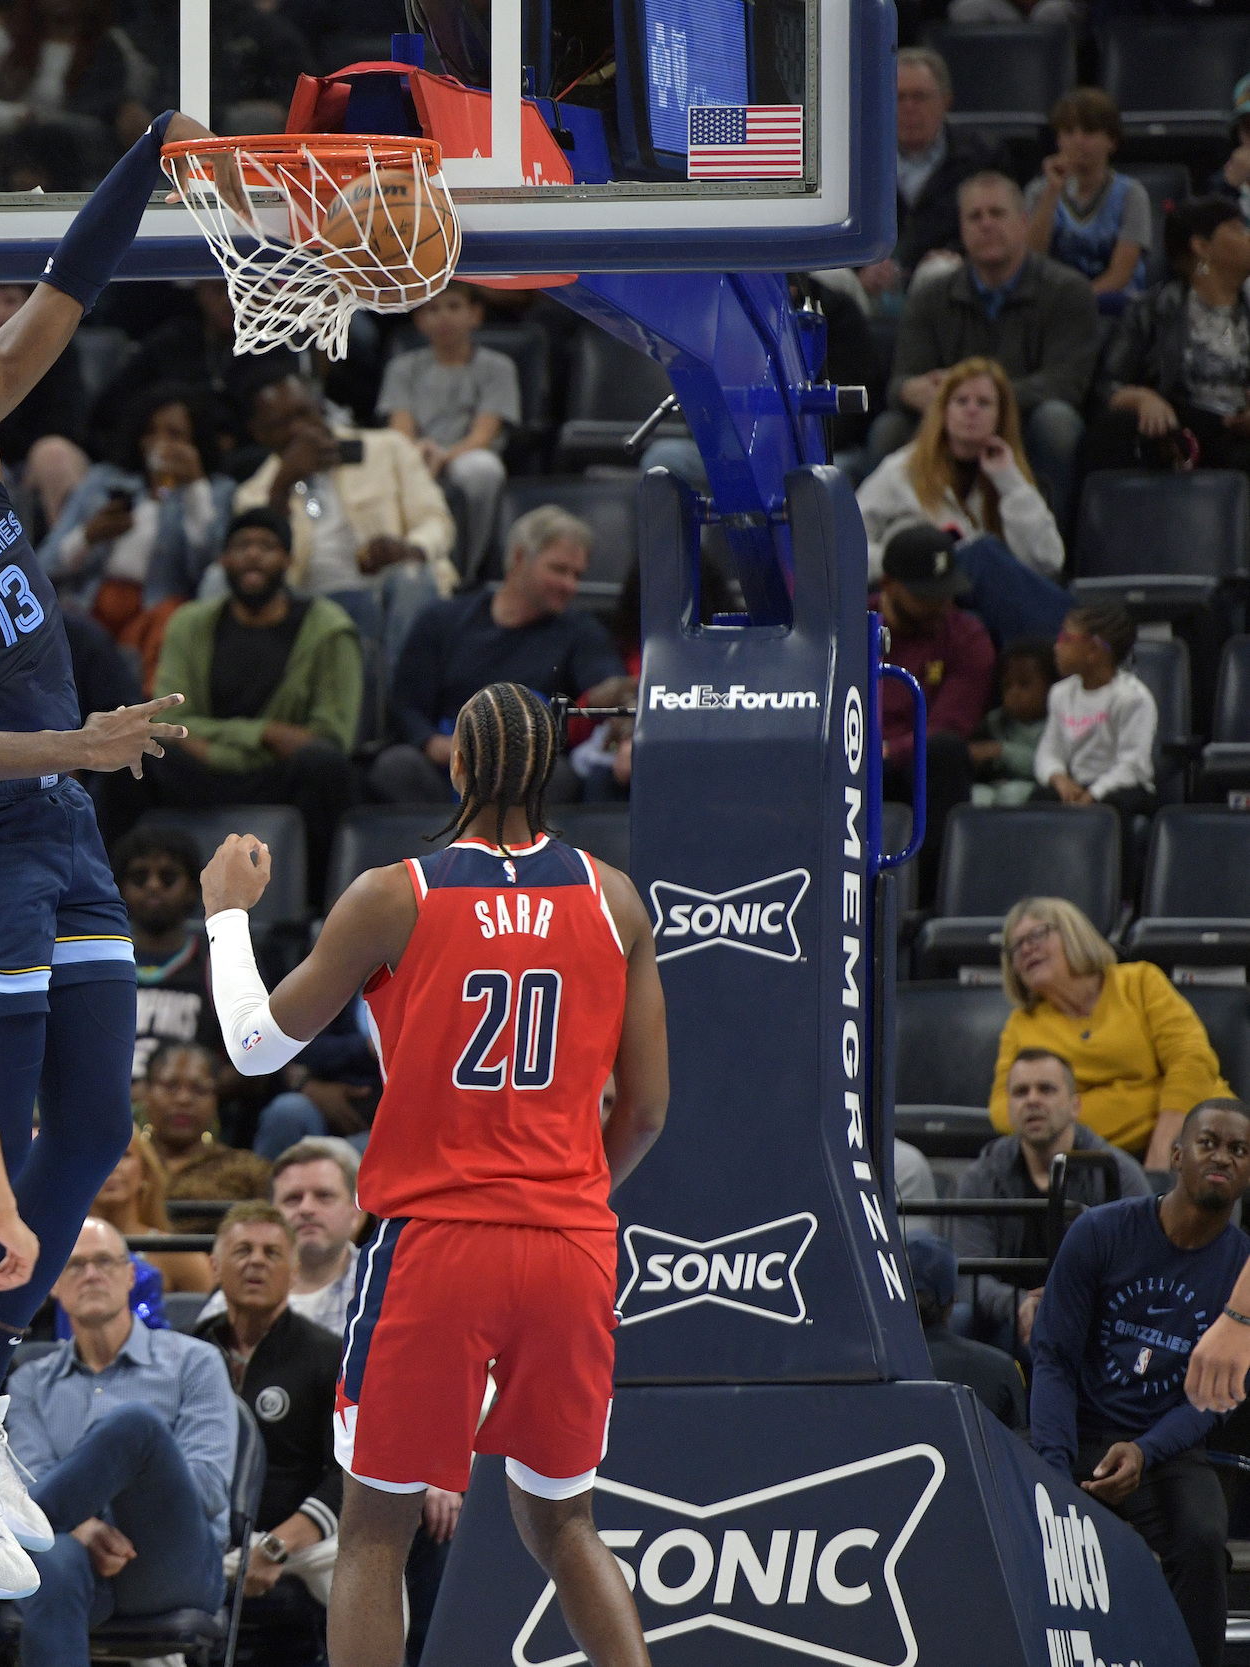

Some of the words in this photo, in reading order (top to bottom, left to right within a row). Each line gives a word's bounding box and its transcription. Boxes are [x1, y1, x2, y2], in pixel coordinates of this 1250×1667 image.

[474, 893, 554, 939] SARR
[662, 901, 786, 936] SONIC
[452, 968, 563, 1091] 20
[639, 1252, 787, 1292] SONIC
[1114, 1319, 1192, 1354] GRIZZLIES
[1035, 1482, 1110, 1615] Auto
